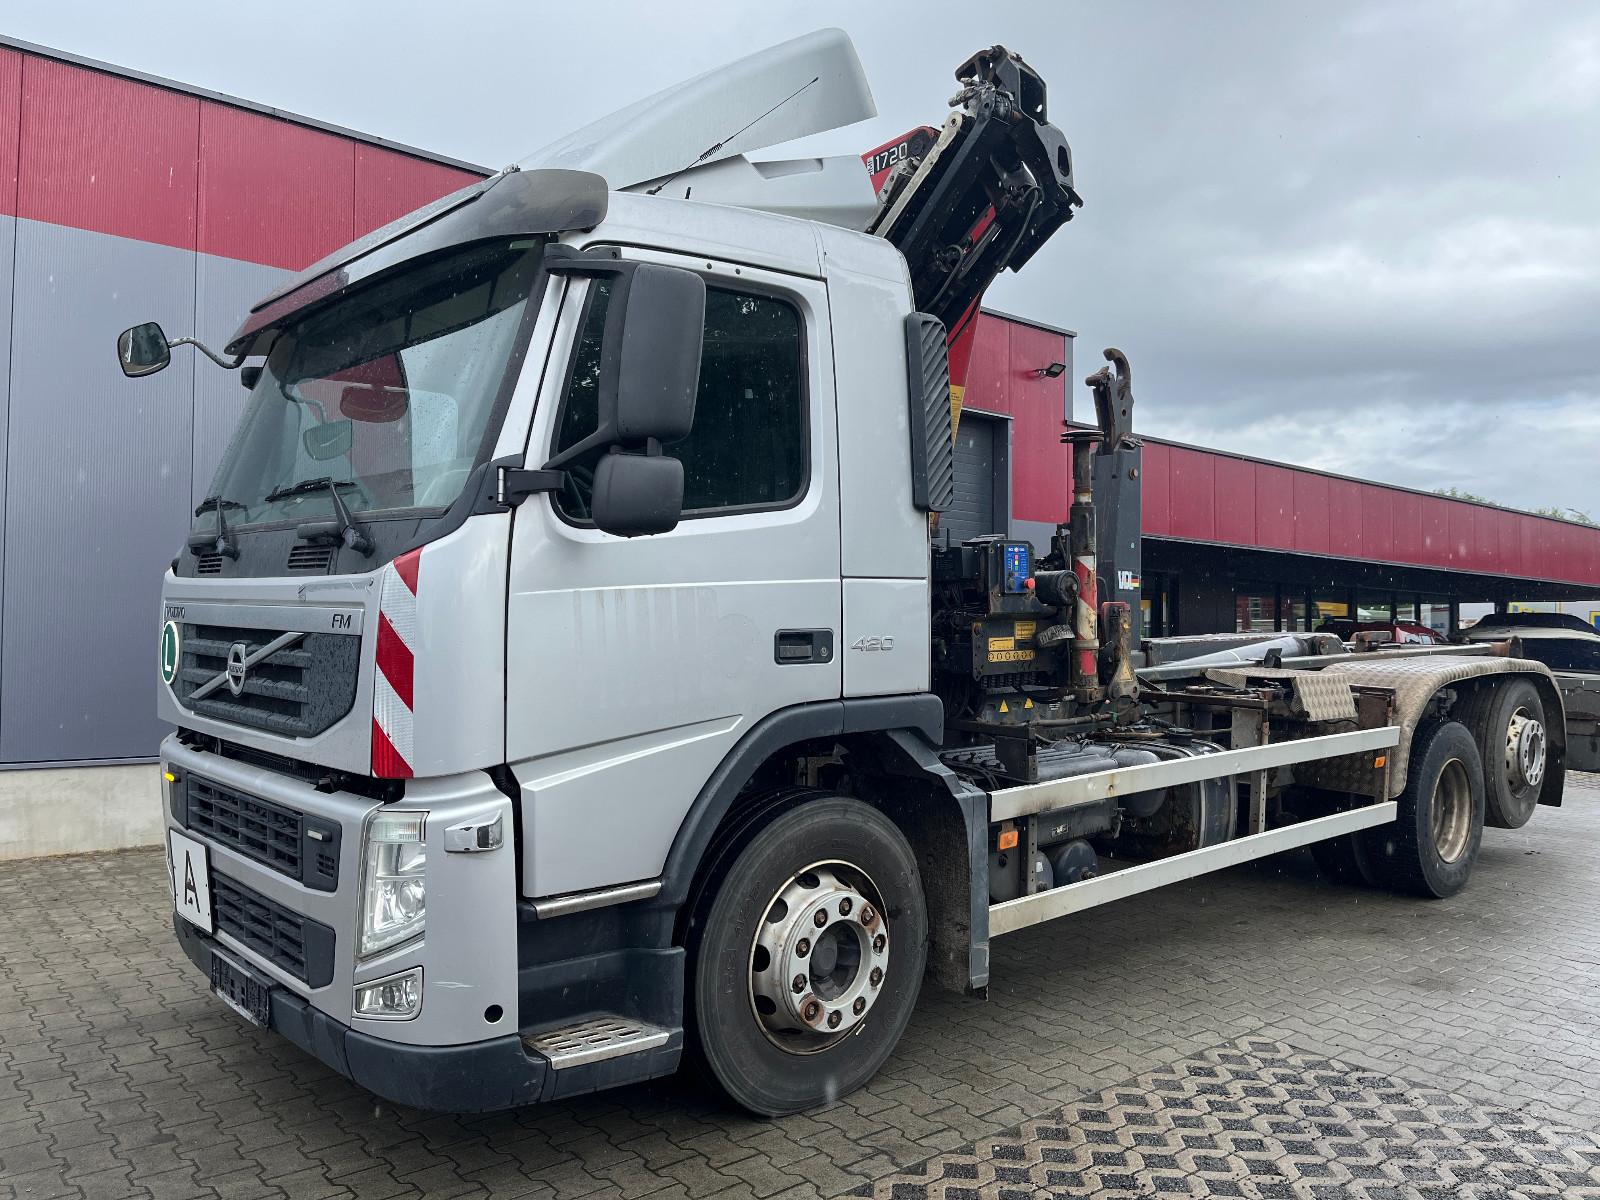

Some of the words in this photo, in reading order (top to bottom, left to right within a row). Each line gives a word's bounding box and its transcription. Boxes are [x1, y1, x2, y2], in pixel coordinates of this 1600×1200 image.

[875, 142, 908, 171] 1720
[332, 614, 351, 629] FM
[165, 634, 172, 672] L
[851, 636, 894, 652] 420
[184, 849, 200, 913] A
